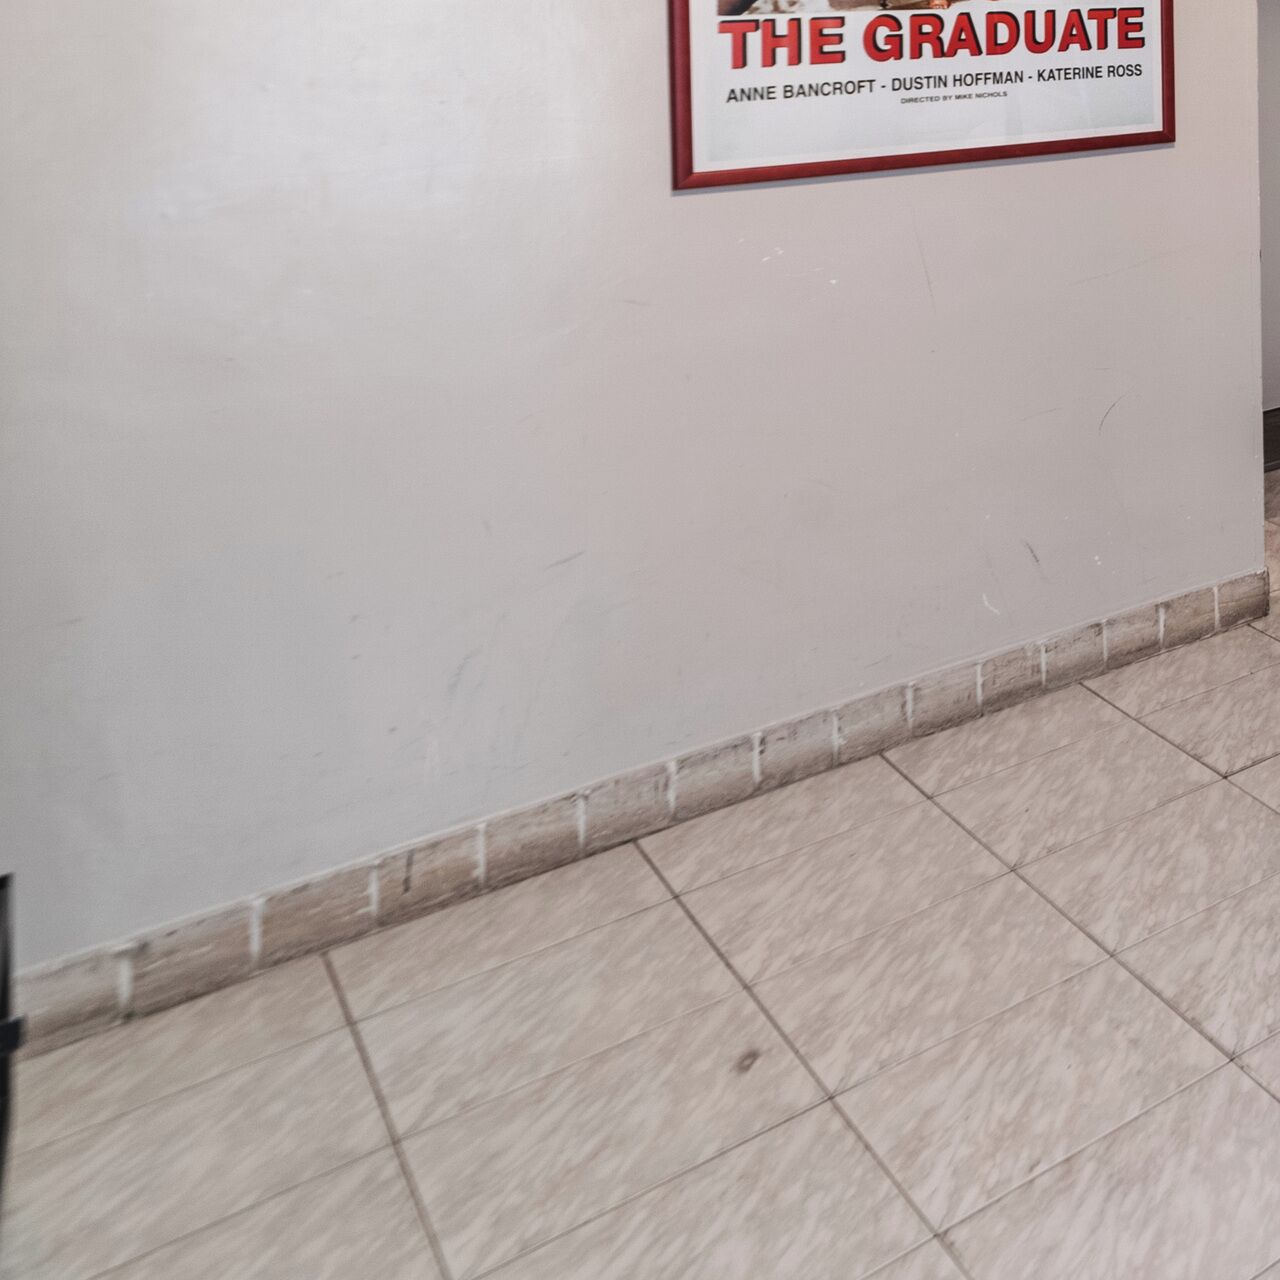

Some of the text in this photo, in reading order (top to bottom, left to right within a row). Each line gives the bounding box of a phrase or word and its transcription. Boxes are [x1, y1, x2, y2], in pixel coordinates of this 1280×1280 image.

[717, 6, 1145, 70] THE GRADUATE
[726, 85, 777, 104] ANNE
[783, 79, 876, 100] BANCROFT
[892, 74, 948, 92] DUSTIN
[953, 70, 1024, 89] HOFFMAN
[1037, 65, 1103, 82] KATERINE
[1107, 63, 1143, 78] ROSS
[900, 91, 1008, 104] DIRECTED BY MIKE NICHOLS
